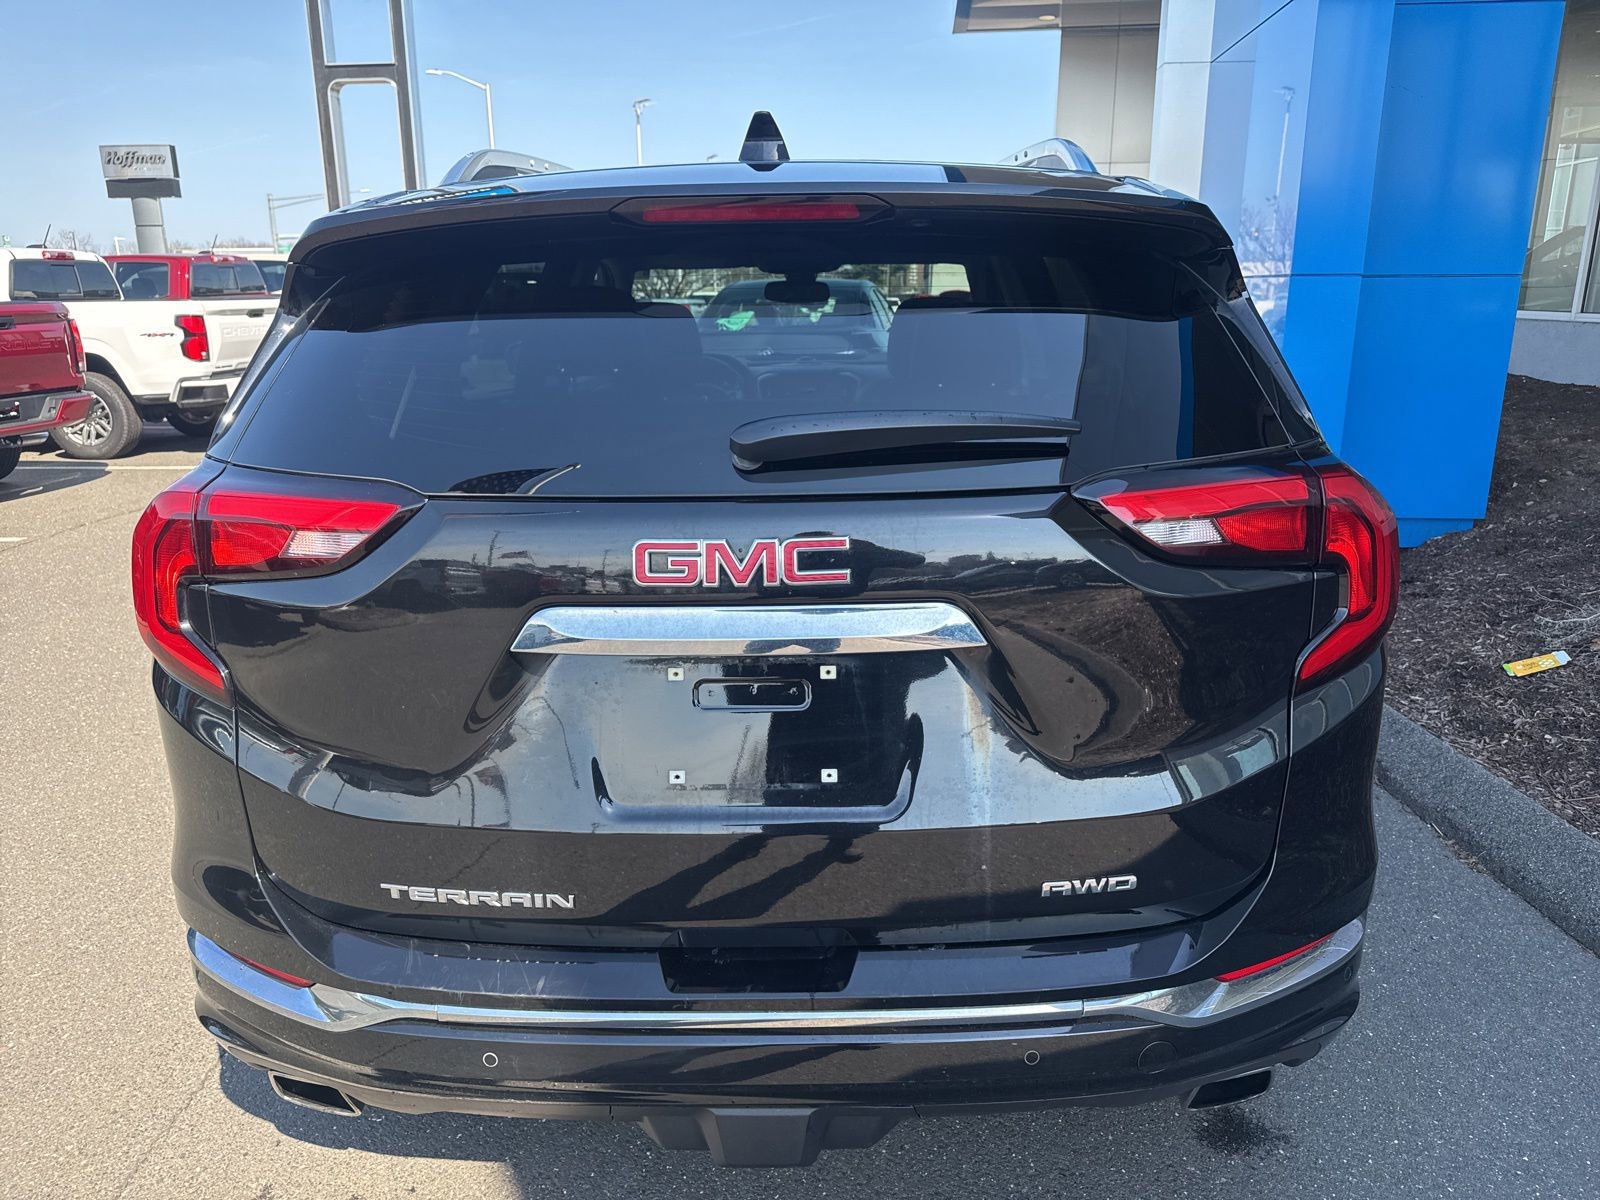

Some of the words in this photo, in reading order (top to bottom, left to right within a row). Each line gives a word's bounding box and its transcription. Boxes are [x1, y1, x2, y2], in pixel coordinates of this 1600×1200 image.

[104, 150, 167, 169] Hoffman
[632, 535, 851, 588] GMC
[379, 882, 575, 910] TERRAIN
[1041, 874, 1138, 897] AWD
